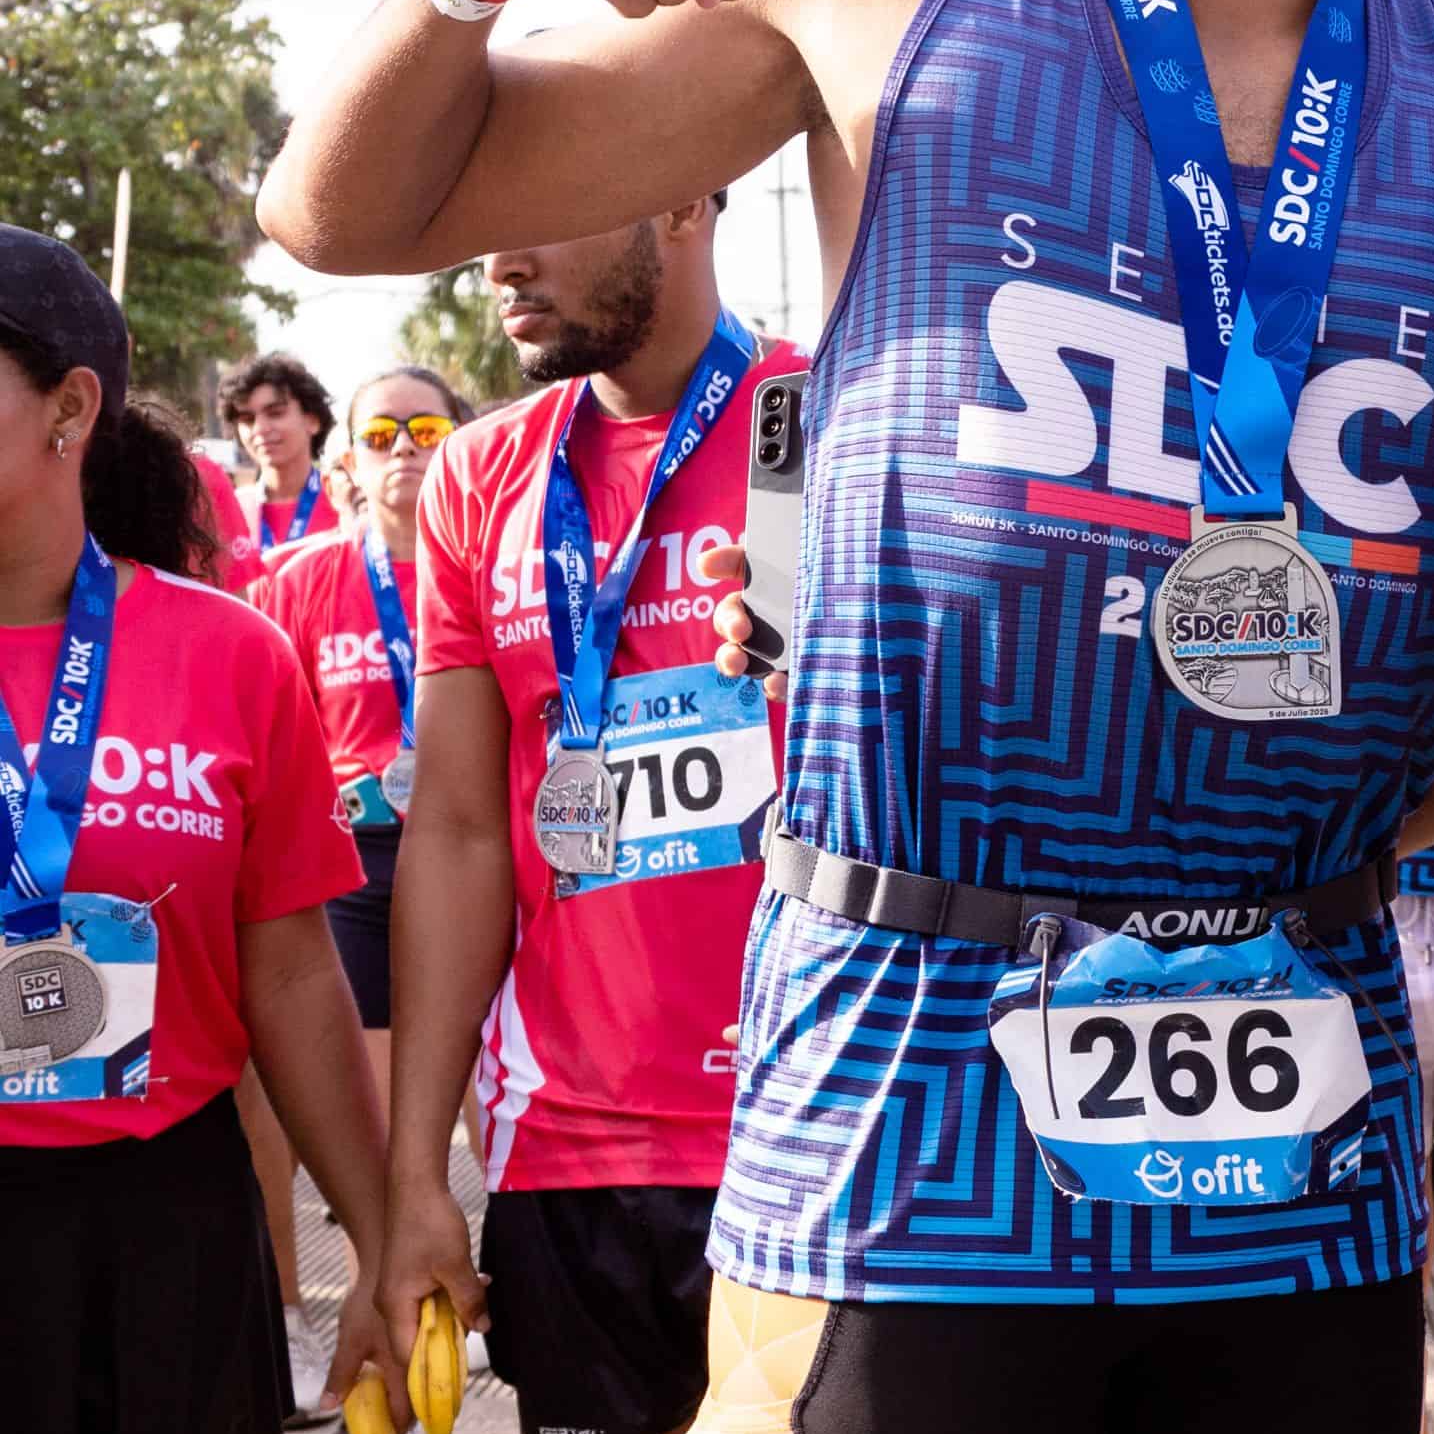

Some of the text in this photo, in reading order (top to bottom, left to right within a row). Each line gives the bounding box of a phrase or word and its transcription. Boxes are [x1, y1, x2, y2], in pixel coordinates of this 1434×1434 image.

[1309, 81, 1353, 250] SANTO DOMINGO CORRE
[1029, 523, 1077, 541] SANTO
[1082, 527, 1149, 552] DOMINGO
[1327, 572, 1417, 593] ANTO DOMINGO
[622, 594, 714, 628] MINGO
[1175, 639, 1321, 656] SANTO DOMINGO CORRE
[136, 804, 224, 841] CORRE
[647, 840, 699, 869] ofit
[24, 973, 59, 992] SDC
[1070, 1008, 1300, 1119] 266
[3, 1071, 60, 1097] ofit
[1192, 1155, 1265, 1196] ofit
